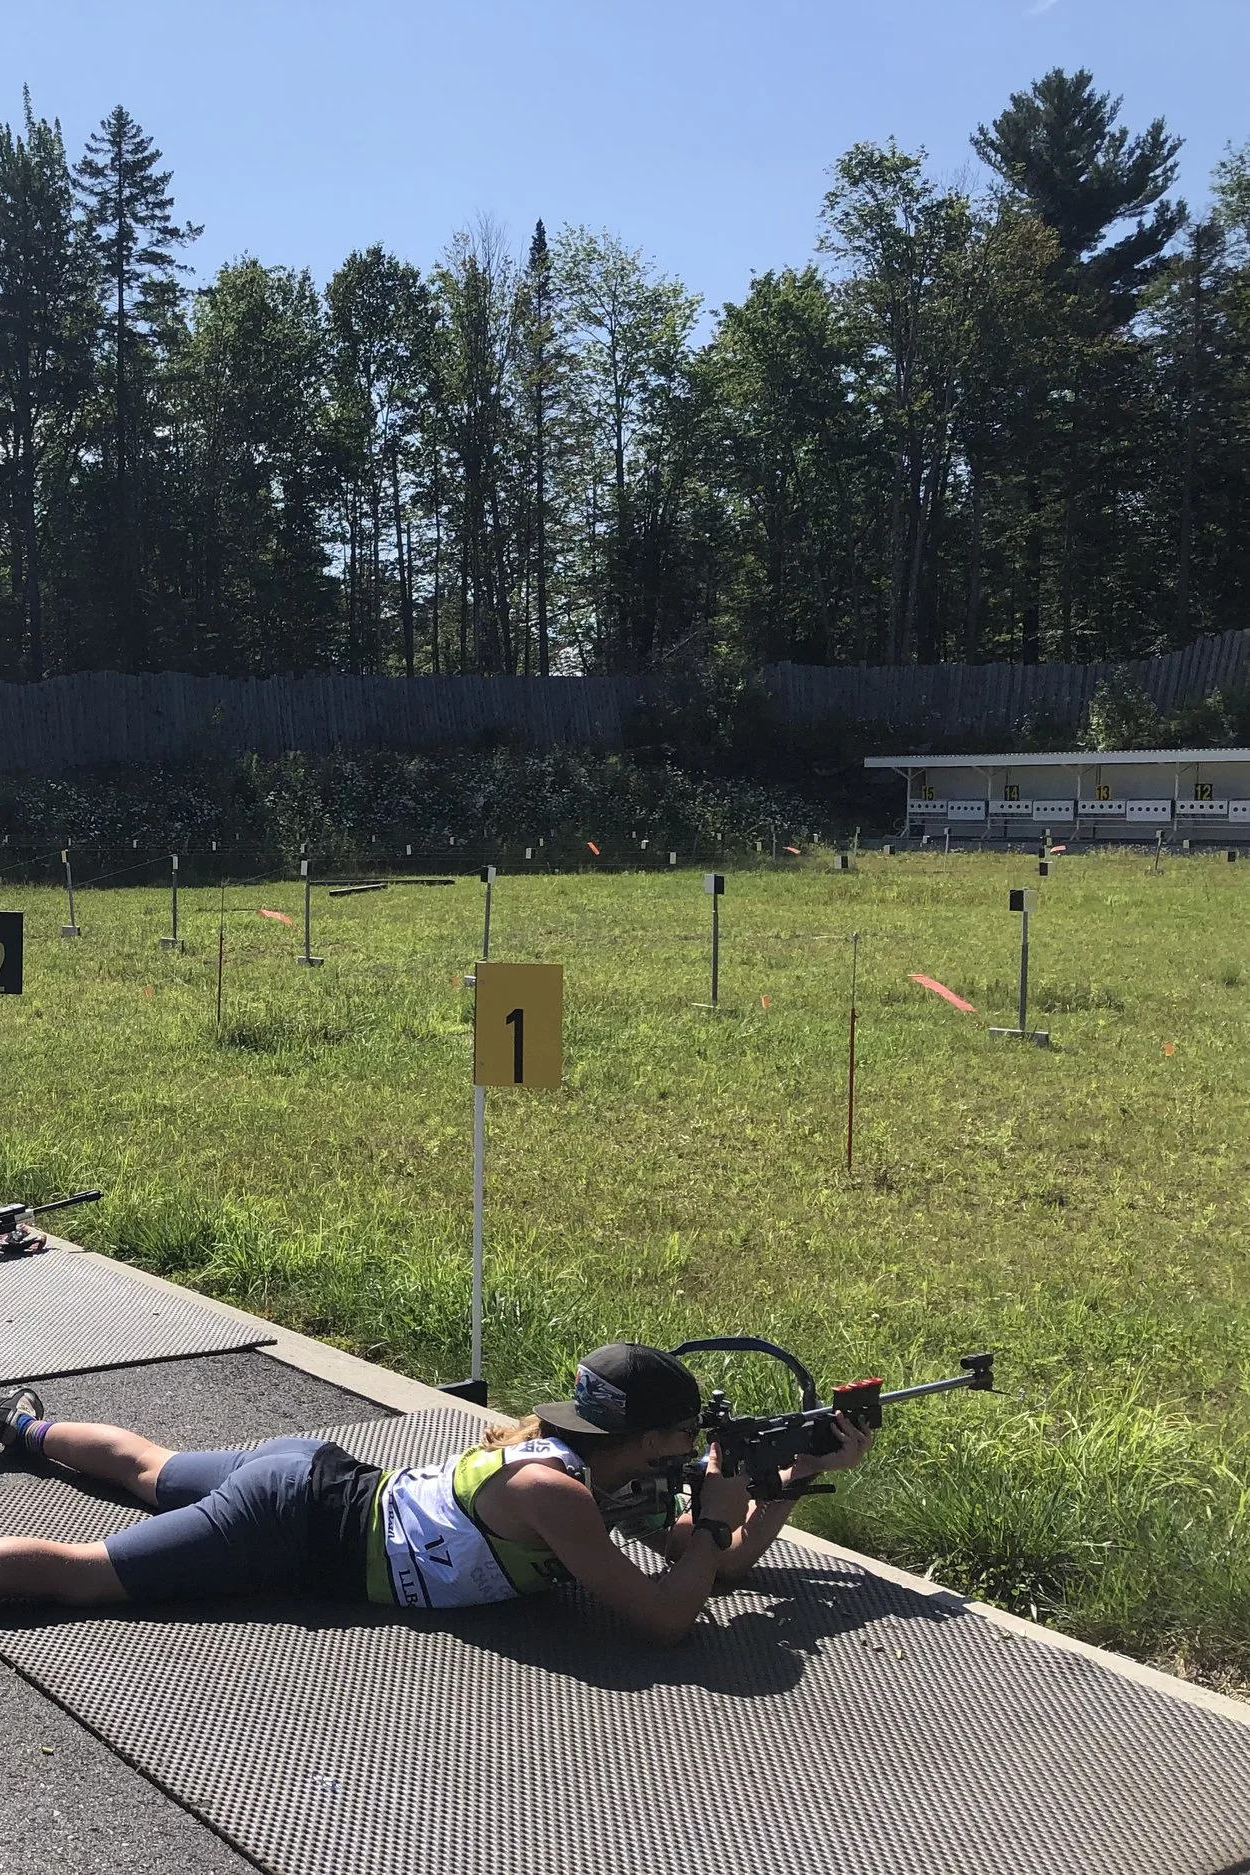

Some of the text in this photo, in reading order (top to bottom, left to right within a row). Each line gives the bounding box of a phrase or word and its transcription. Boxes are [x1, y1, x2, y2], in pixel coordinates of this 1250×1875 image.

[923, 787, 934, 800] 15
[1006, 786, 1018, 800] 14
[1096, 786, 1110, 800] 13
[1196, 785, 1211, 799] 12
[505, 1008, 524, 1084] 1
[424, 1534, 453, 1568] 17
